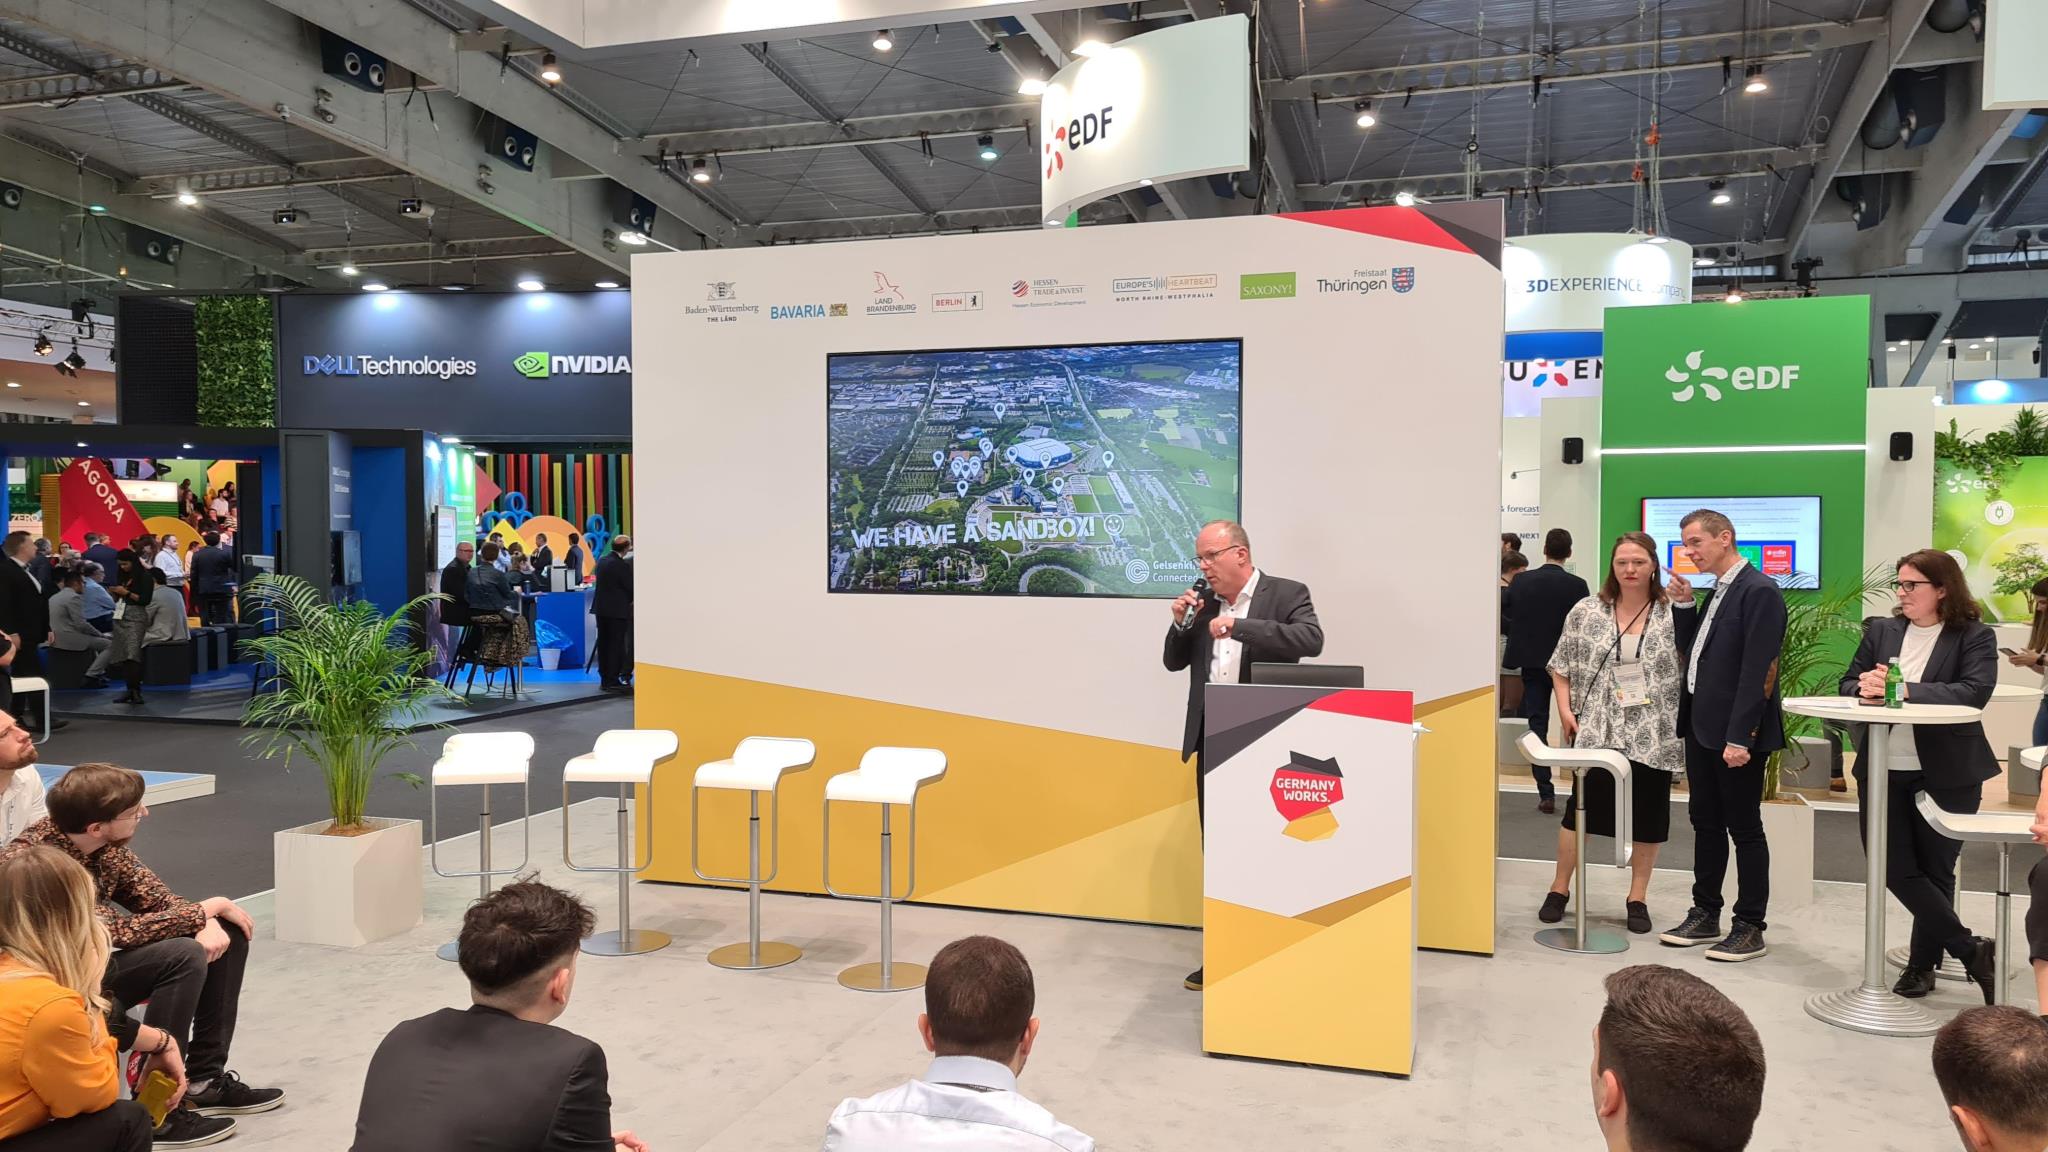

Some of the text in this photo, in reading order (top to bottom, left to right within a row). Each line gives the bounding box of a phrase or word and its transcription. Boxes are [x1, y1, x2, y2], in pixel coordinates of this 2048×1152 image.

[1354, 269, 1387, 277] Freistaat
[1116, 277, 1213, 289] EUROPE'S HEARTBEAT
[1317, 279, 1387, 294] Thüringen
[1243, 284, 1294, 296] SAXONY!
[866, 304, 917, 312] BRANDENBURG
[936, 298, 962, 306] BERLIN
[685, 303, 760, 315] Baden-Württemberg
[770, 304, 826, 320] BAVARIA
[303, 354, 477, 379] DELL Technologies
[78, 459, 125, 524] AGORA
[11, 513, 38, 521] ZERO
[851, 516, 1095, 548] WE HAVE A SANDBOX!
[1153, 572, 1198, 582] Connected
[1276, 778, 1336, 791] GERMANY
[1283, 790, 1331, 803] WORKS.
